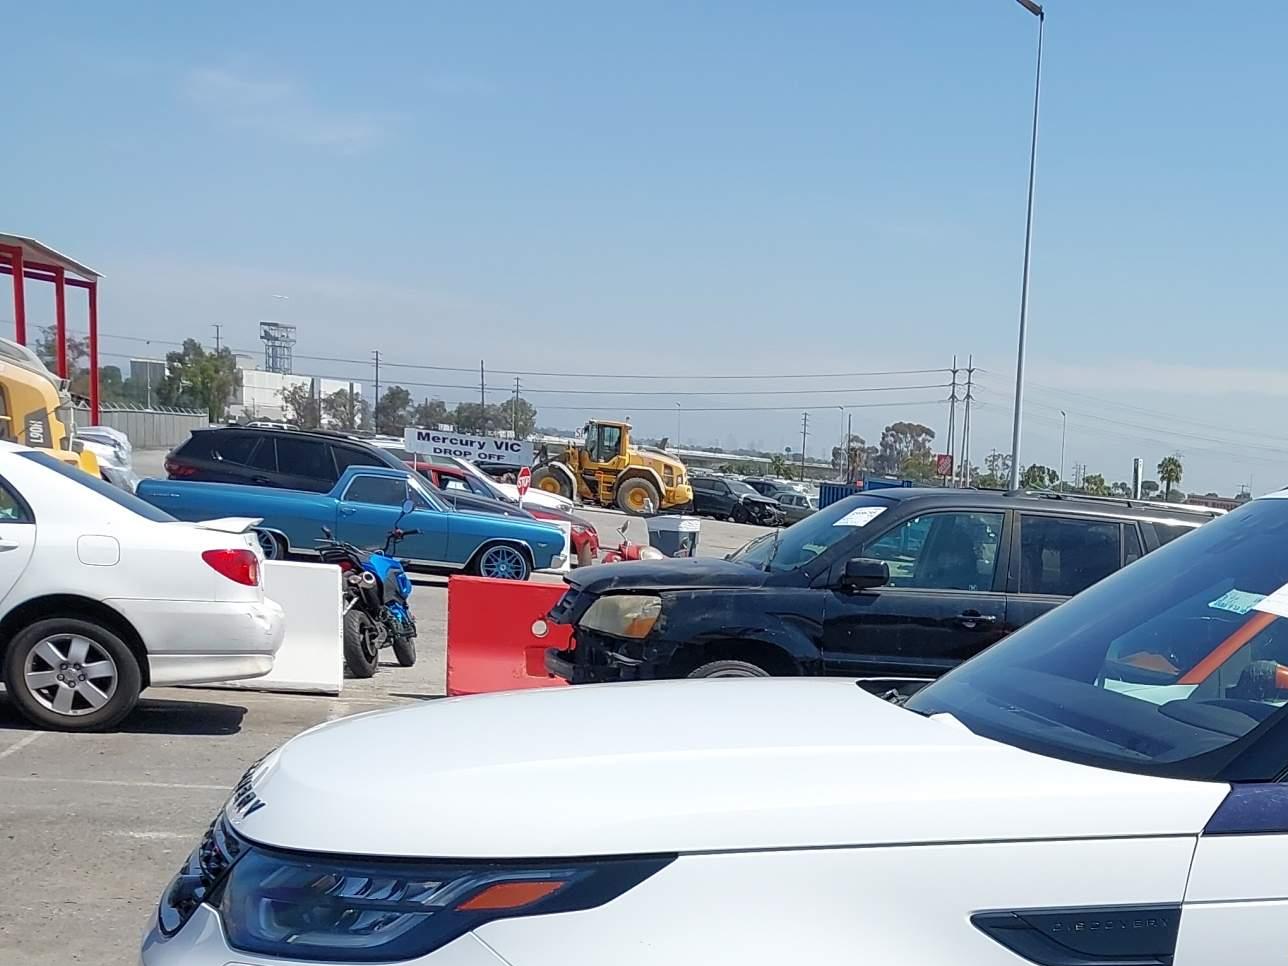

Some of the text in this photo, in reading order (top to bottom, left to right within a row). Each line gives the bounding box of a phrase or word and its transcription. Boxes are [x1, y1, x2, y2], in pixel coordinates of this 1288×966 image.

[417, 431, 521, 452] Mercury VIC
[433, 447, 505, 461] DROP OFF
[517, 476, 530, 488] STOP
